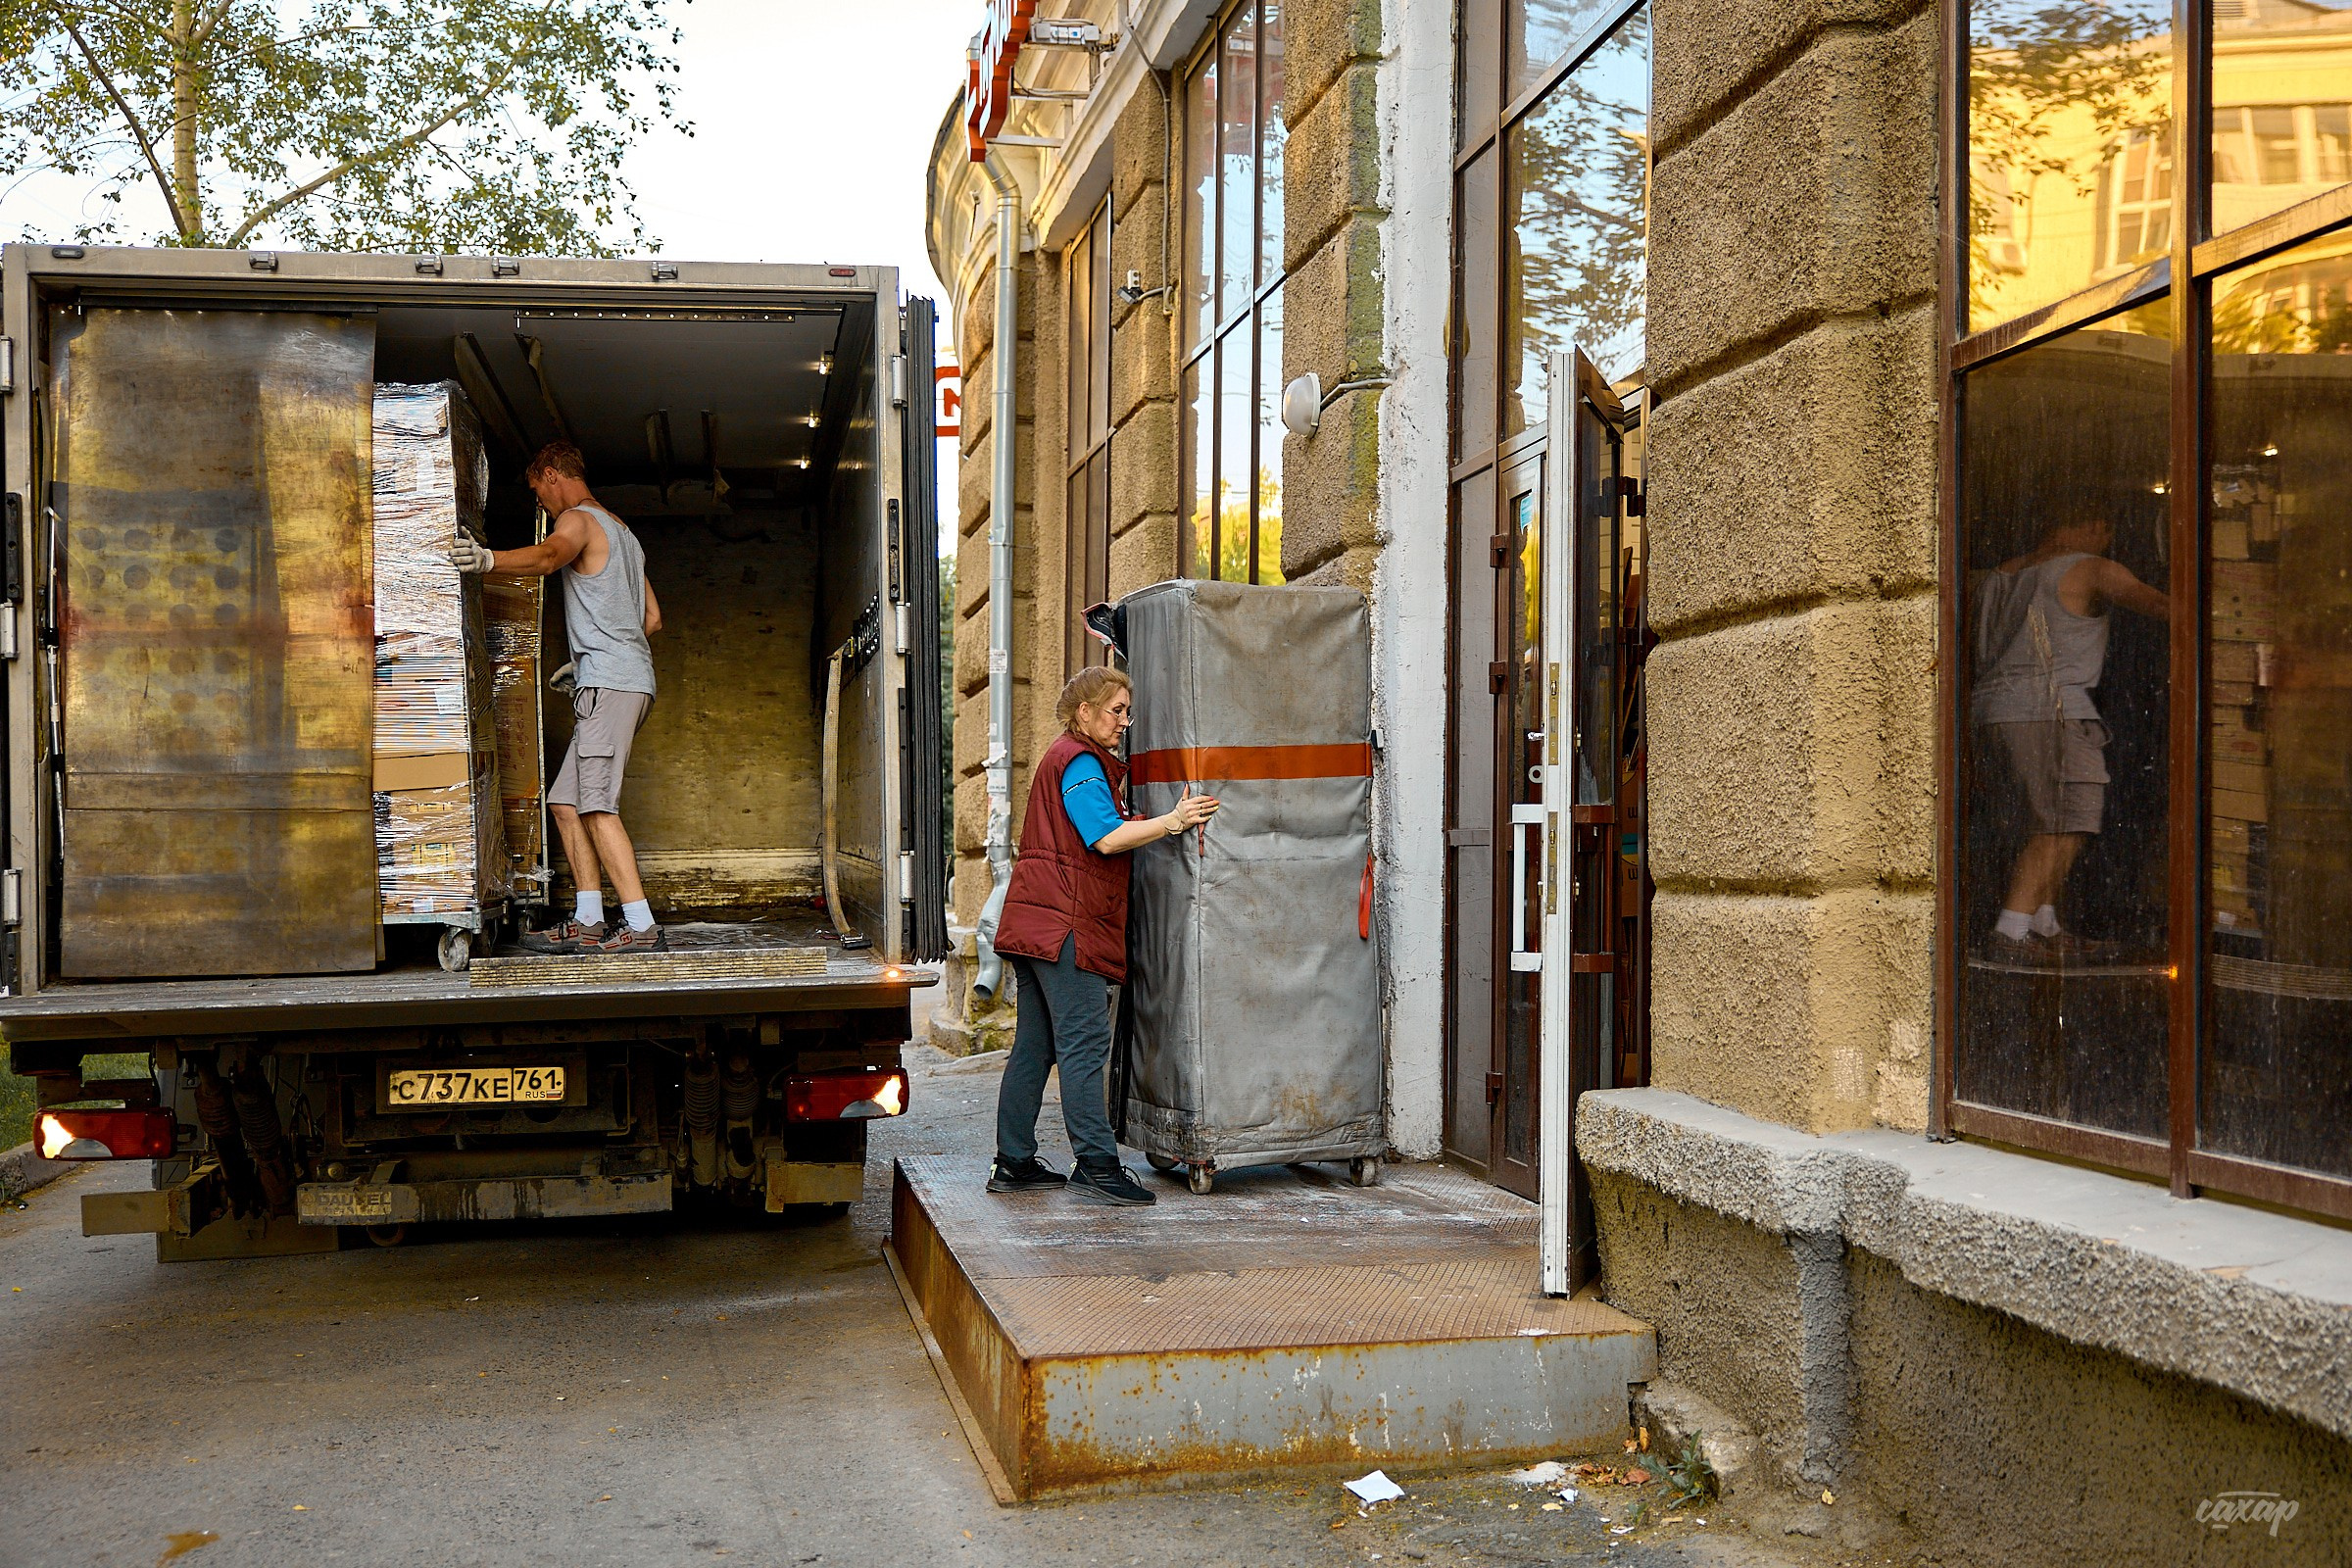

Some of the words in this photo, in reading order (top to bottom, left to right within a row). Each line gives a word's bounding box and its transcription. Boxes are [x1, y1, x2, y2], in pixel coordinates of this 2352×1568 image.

[398, 1072, 509, 1101] С737КЕ
[514, 1069, 557, 1091] 761
[318, 1192, 391, 1206] DAUEL
